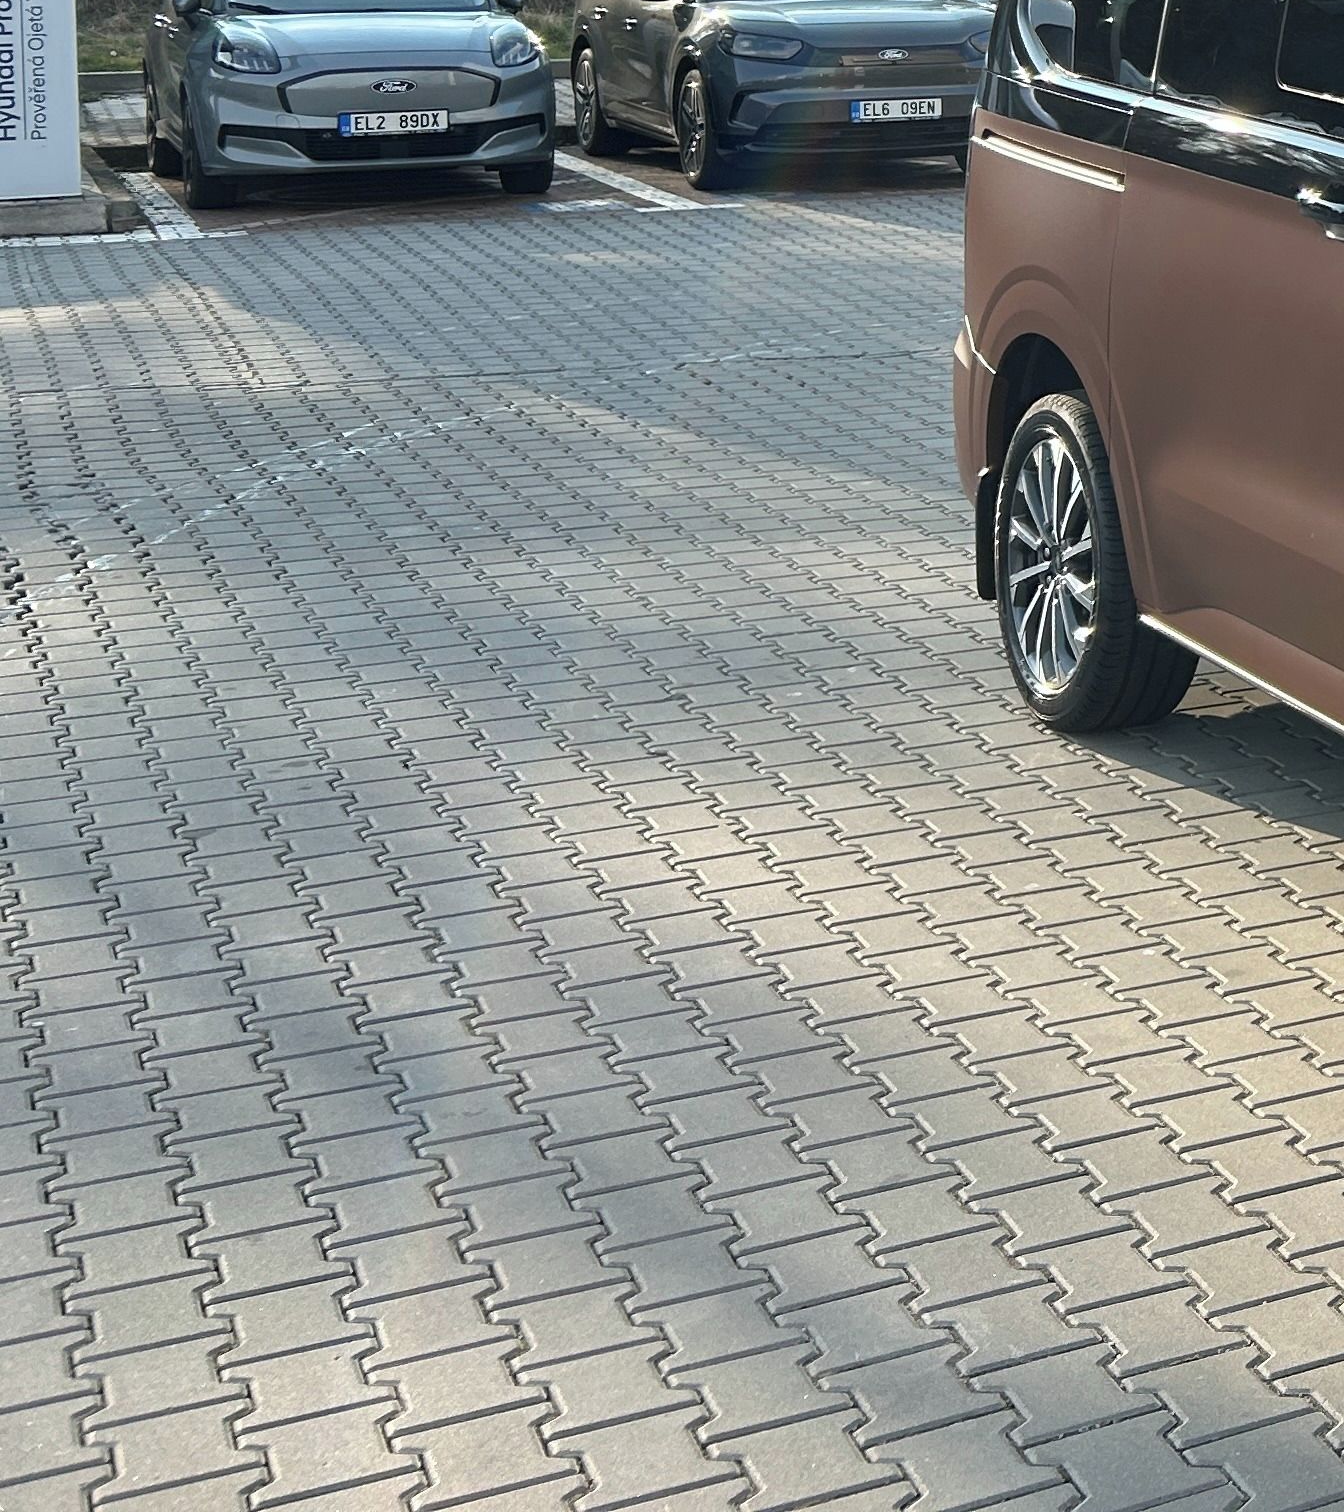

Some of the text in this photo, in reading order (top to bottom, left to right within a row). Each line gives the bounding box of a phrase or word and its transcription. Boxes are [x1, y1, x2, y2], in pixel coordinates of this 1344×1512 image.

[25, 5, 48, 51] Ojetá
[863, 102, 890, 117] EL6
[901, 100, 936, 115] 09EN
[354, 112, 440, 131] EL2 89DX
